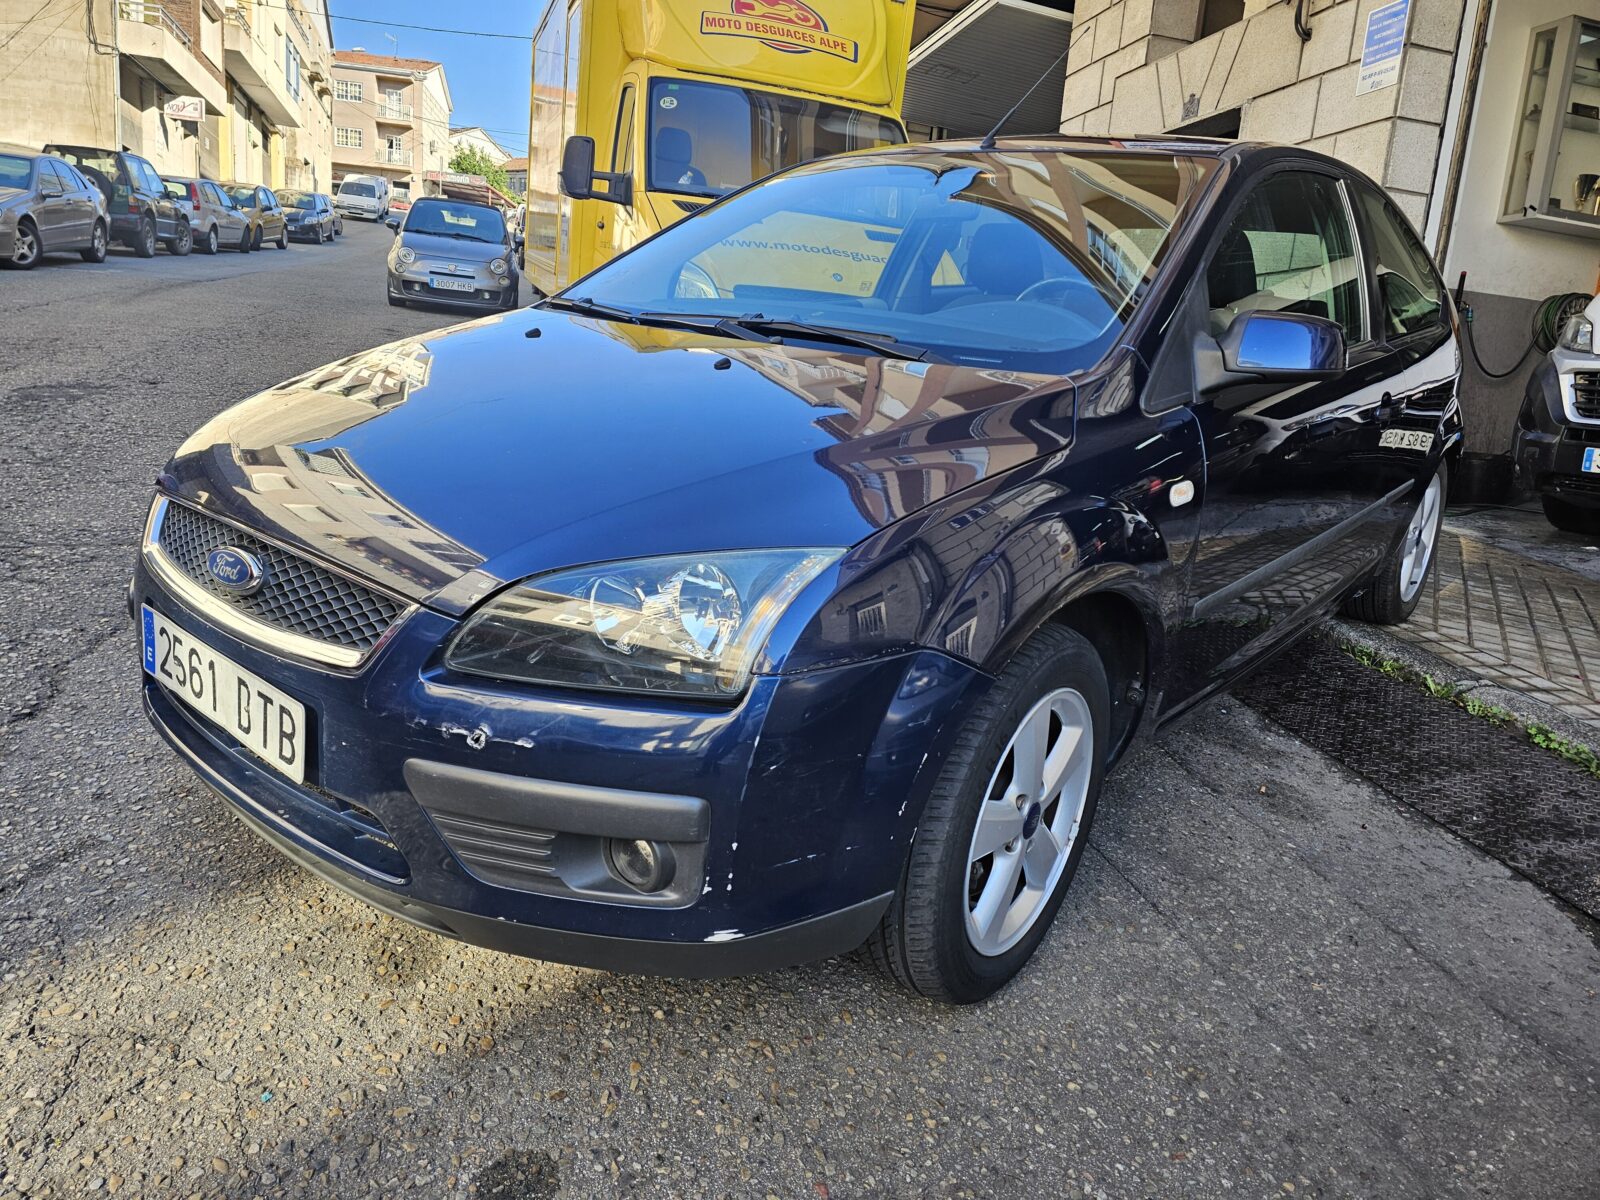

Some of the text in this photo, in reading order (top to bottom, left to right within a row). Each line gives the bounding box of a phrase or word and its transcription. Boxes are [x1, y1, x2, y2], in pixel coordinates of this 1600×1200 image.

[705, 16, 848, 53] MOTO DESGUACES ALPE
[435, 279, 455, 289] 3007
[212, 553, 241, 580] Ford
[147, 646, 153, 662] E
[159, 626, 217, 712] 2561
